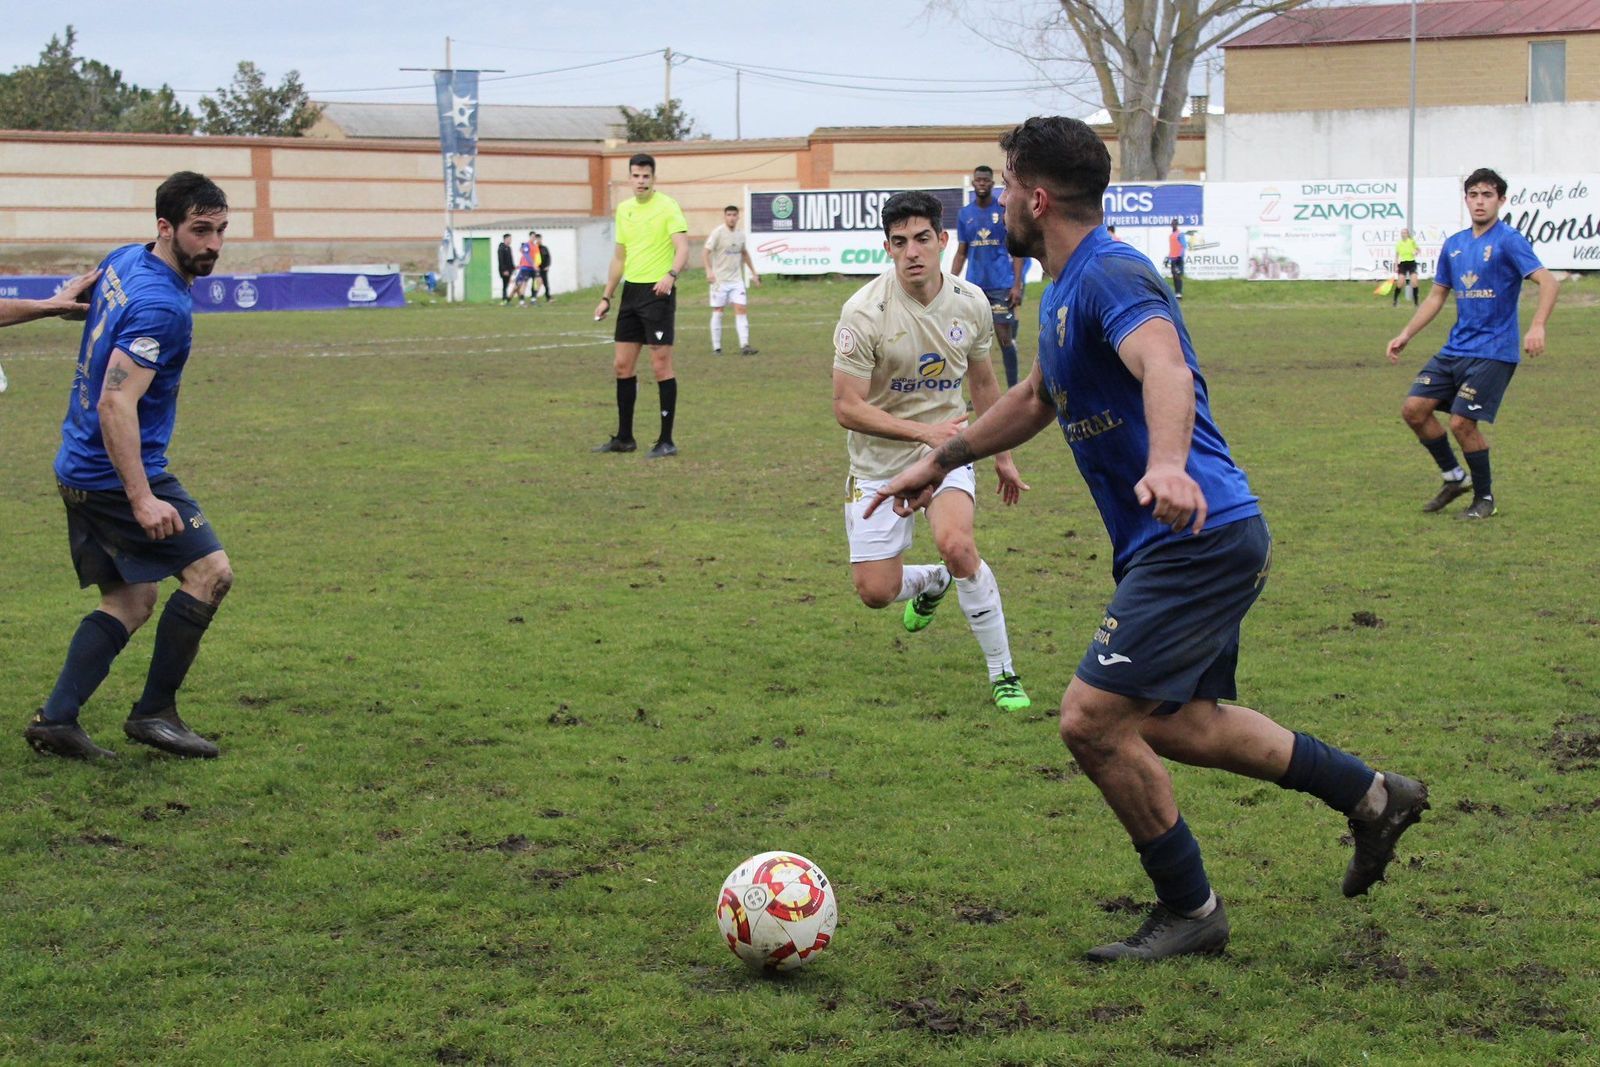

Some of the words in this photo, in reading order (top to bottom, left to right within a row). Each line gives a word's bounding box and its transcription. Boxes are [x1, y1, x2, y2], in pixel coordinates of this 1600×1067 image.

[1510, 187, 1526, 206] el
[1530, 184, 1564, 209] café
[1568, 180, 1589, 198] de
[1294, 202, 1404, 221] ZAMORA
[1182, 255, 1239, 265] ARRILLO
